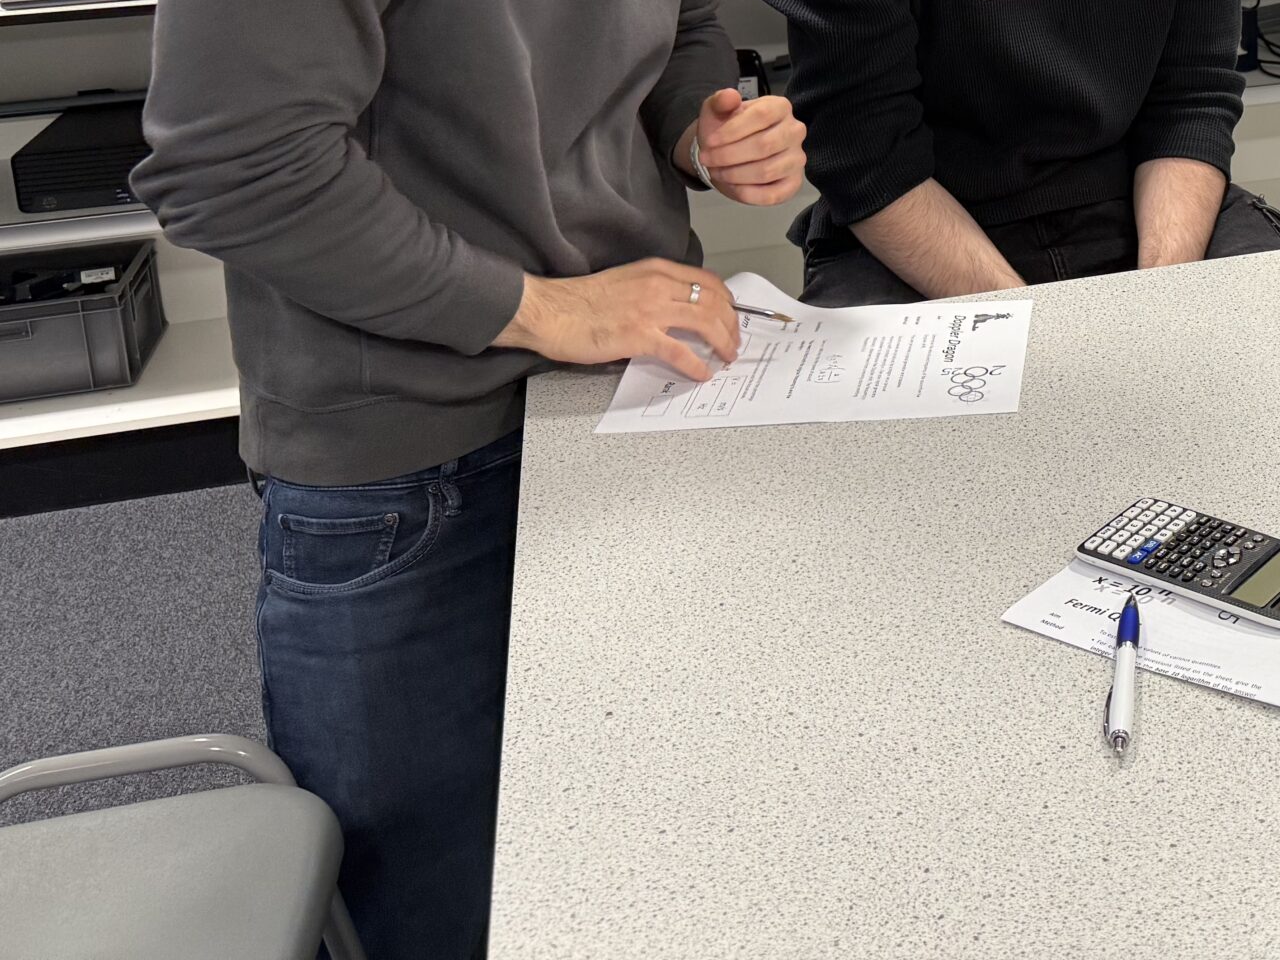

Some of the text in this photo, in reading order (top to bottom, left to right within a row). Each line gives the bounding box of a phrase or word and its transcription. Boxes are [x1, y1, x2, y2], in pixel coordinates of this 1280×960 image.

[942, 314, 967, 363] Doppler Dragon
[1064, 598, 1110, 616] Fermi
[1040, 619, 1065, 630] Method
